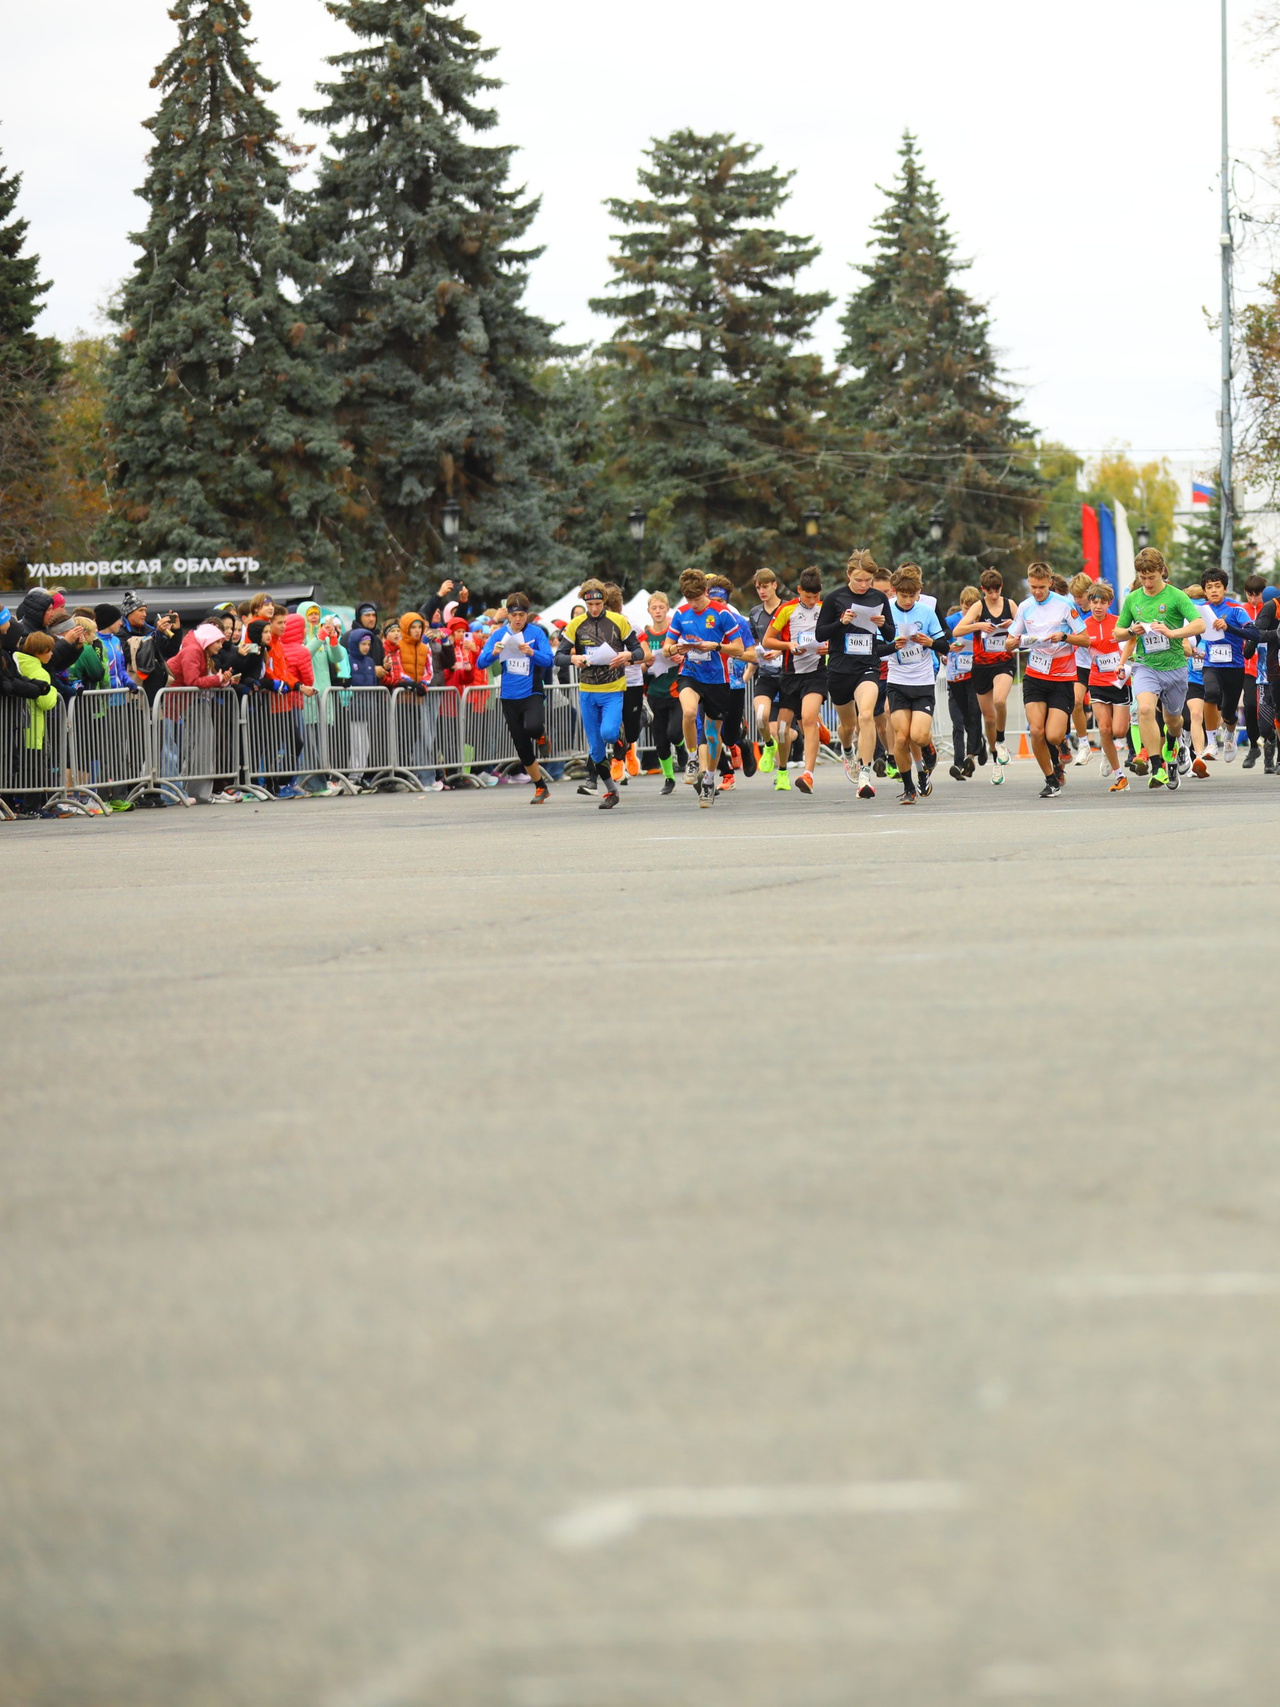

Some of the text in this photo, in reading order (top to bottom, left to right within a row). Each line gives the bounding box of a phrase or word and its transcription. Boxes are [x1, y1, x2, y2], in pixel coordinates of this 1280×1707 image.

[26, 556, 260, 578] УЛЬЯНОВСКАЯ ОБЛАСТЬ
[848, 638, 869, 647] 308.1
[1145, 635, 1164, 646] 312.1
[901, 647, 920, 659] 310.1
[508, 660, 526, 668] 321.1
[1031, 655, 1048, 666] 327.1
[1099, 657, 1117, 666] 309.1
